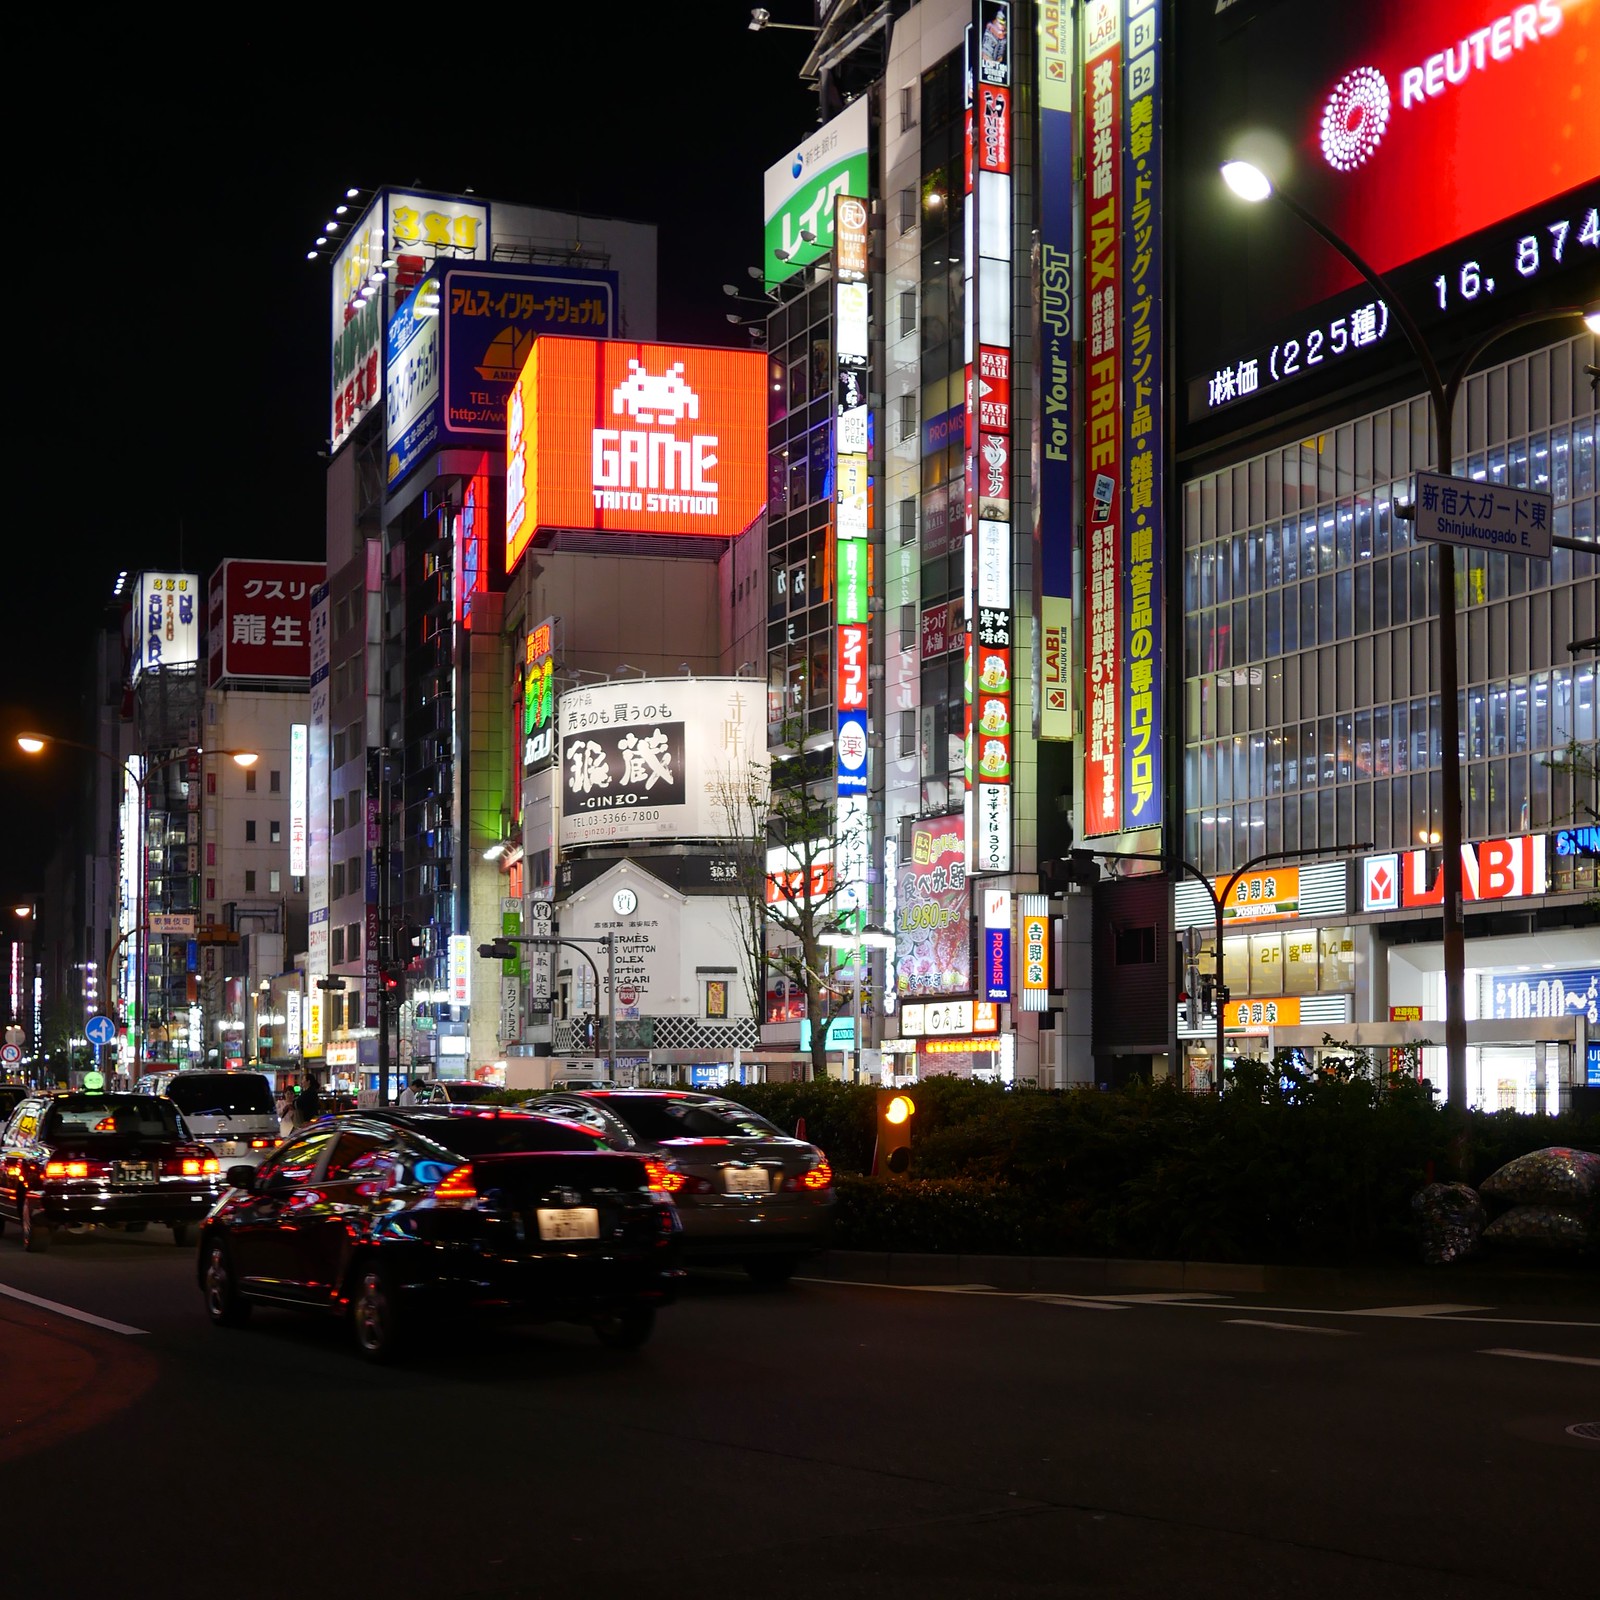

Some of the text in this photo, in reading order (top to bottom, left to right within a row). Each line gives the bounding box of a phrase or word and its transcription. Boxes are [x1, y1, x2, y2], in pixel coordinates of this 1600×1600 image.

[1089, 15, 1117, 47] LABI
[1134, 24, 1150, 48] B1
[1400, 0, 1565, 108] REUTERS
[1133, 66, 1151, 90] B2
[805, 129, 839, 167] 新生銀行
[393, 206, 481, 248] 389
[782, 169, 850, 263] レイク
[844, 242, 861, 253] CAFE
[1091, 197, 1115, 472] TAX FREE
[982, 355, 1008, 368] FAST
[1043, 244, 1070, 462] For Your JUST
[982, 366, 1008, 379] NAIL
[845, 417, 860, 427] HOT
[982, 402, 1008, 416] FAST
[982, 414, 1008, 427] NAIL
[929, 414, 965, 445] PROMIS
[592, 428, 719, 493] GAME
[987, 434, 1004, 498] マツエク
[592, 490, 719, 516] TAITO STATION
[1422, 482, 1548, 531] 新宿大ガード東
[1437, 517, 1532, 548] Shinjukuogado E.
[231, 613, 312, 647] 龍生
[922, 609, 947, 634] まつげ
[979, 608, 1009, 628] 炭火
[979, 628, 1009, 646] 焼肉
[843, 628, 863, 706] アイフル
[1045, 626, 1060, 683] LABI
[567, 702, 673, 731] 売るのも買うのも
[566, 727, 675, 794] 銀蔵
[573, 810, 660, 829] TEL.03-5366-7800
[901, 863, 966, 901] 食べ放題
[1402, 836, 1535, 907] LABI
[1236, 877, 1277, 902] 吉野家
[1236, 904, 1277, 917] YOSHINOYA
[614, 933, 649, 943] ERMÈS
[622, 945, 656, 953] VUITTON
[615, 955, 644, 963] OLEX
[992, 932, 1004, 985] PROMISE
[1028, 922, 1043, 983] 吉野家
[1260, 947, 1280, 963] 2F
[603, 976, 650, 984] BLGARI
[607, 965, 646, 973] artier
[1237, 1002, 1278, 1024] 吉野家
